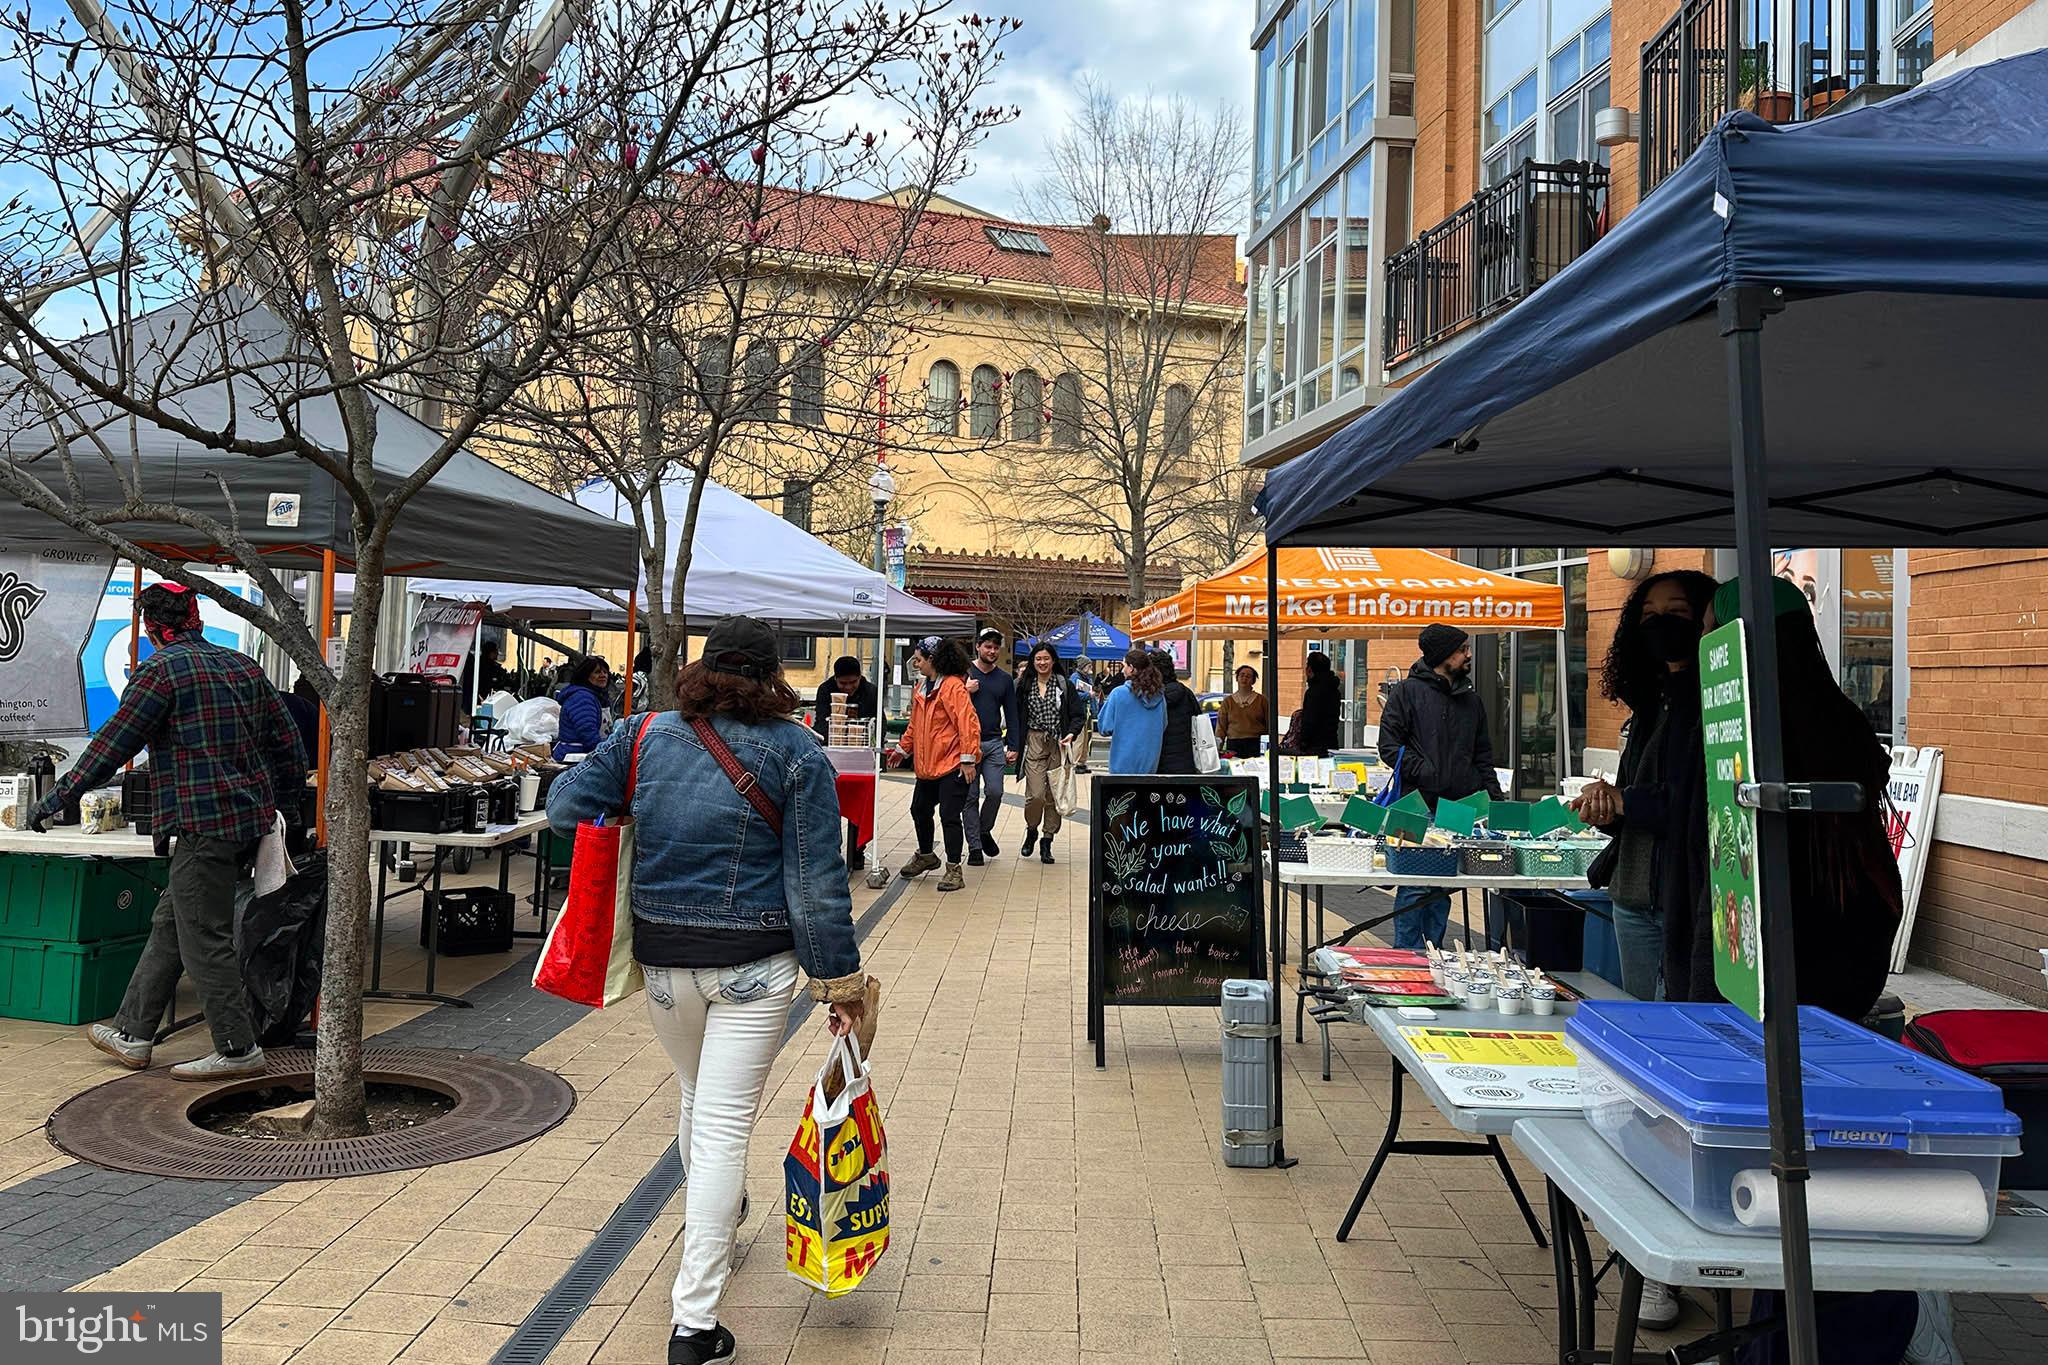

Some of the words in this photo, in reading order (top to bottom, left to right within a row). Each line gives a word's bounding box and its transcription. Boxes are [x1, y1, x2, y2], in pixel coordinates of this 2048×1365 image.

[42, 548, 99, 564] GROWLERS
[932, 597, 948, 605] HOT
[1347, 593, 1534, 618] Information
[1709, 643, 1729, 672] SAMPLE
[37, 698, 48, 707] DC
[1714, 678, 1742, 706] AUTHENTIC
[1903, 783, 1920, 803] BAR
[1120, 811, 1150, 842] We
[1160, 805, 1194, 832] have
[1200, 810, 1241, 838] what
[1150, 843, 1192, 869] your
[1124, 873, 1168, 895] salad
[1135, 903, 1210, 937] cheese
[1118, 945, 1139, 962] feta
[1832, 1129, 1889, 1145] Hefty
